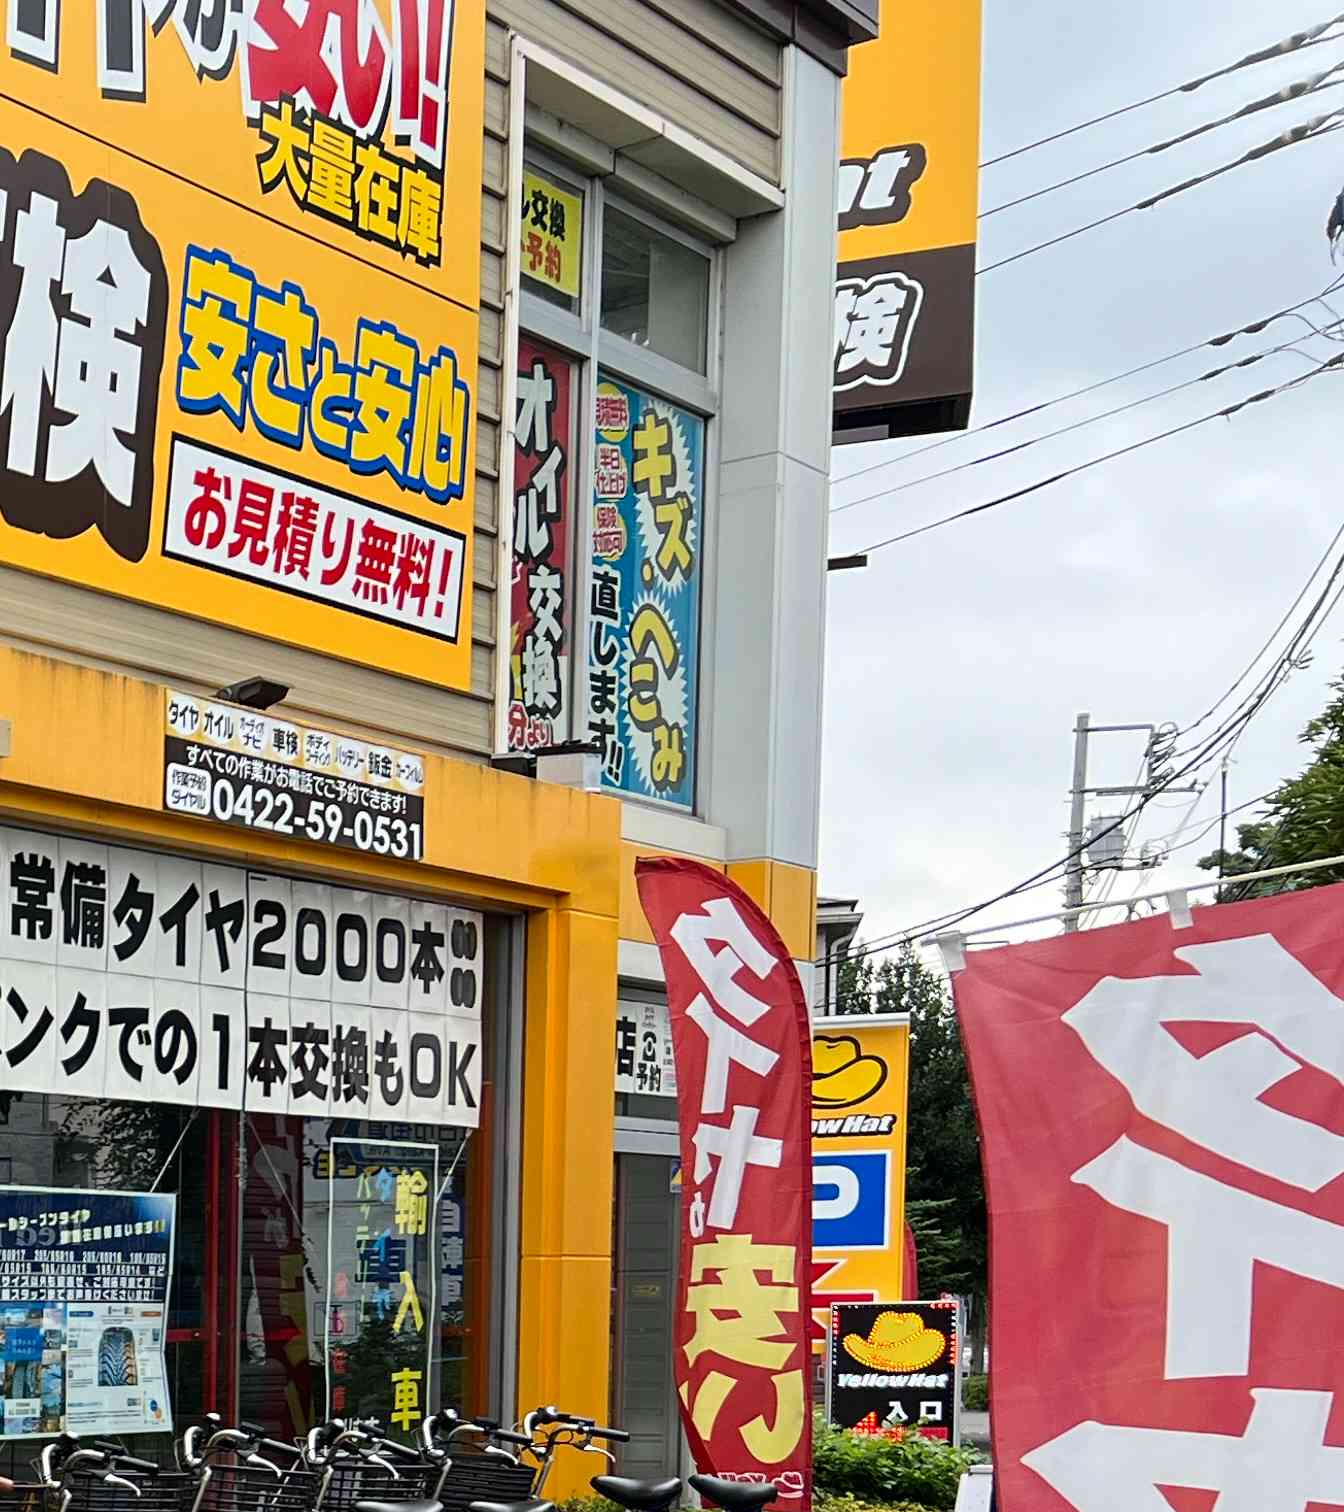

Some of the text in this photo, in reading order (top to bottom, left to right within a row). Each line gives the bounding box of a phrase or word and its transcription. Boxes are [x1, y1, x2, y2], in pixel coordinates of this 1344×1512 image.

[258, 98, 444, 264] 大量在庫
[178, 248, 470, 502] 安さと安心
[169, 699, 199, 730] タイヤ
[213, 778, 420, 861] 0422-59-0531
[811, 1114, 896, 1135] wHat
